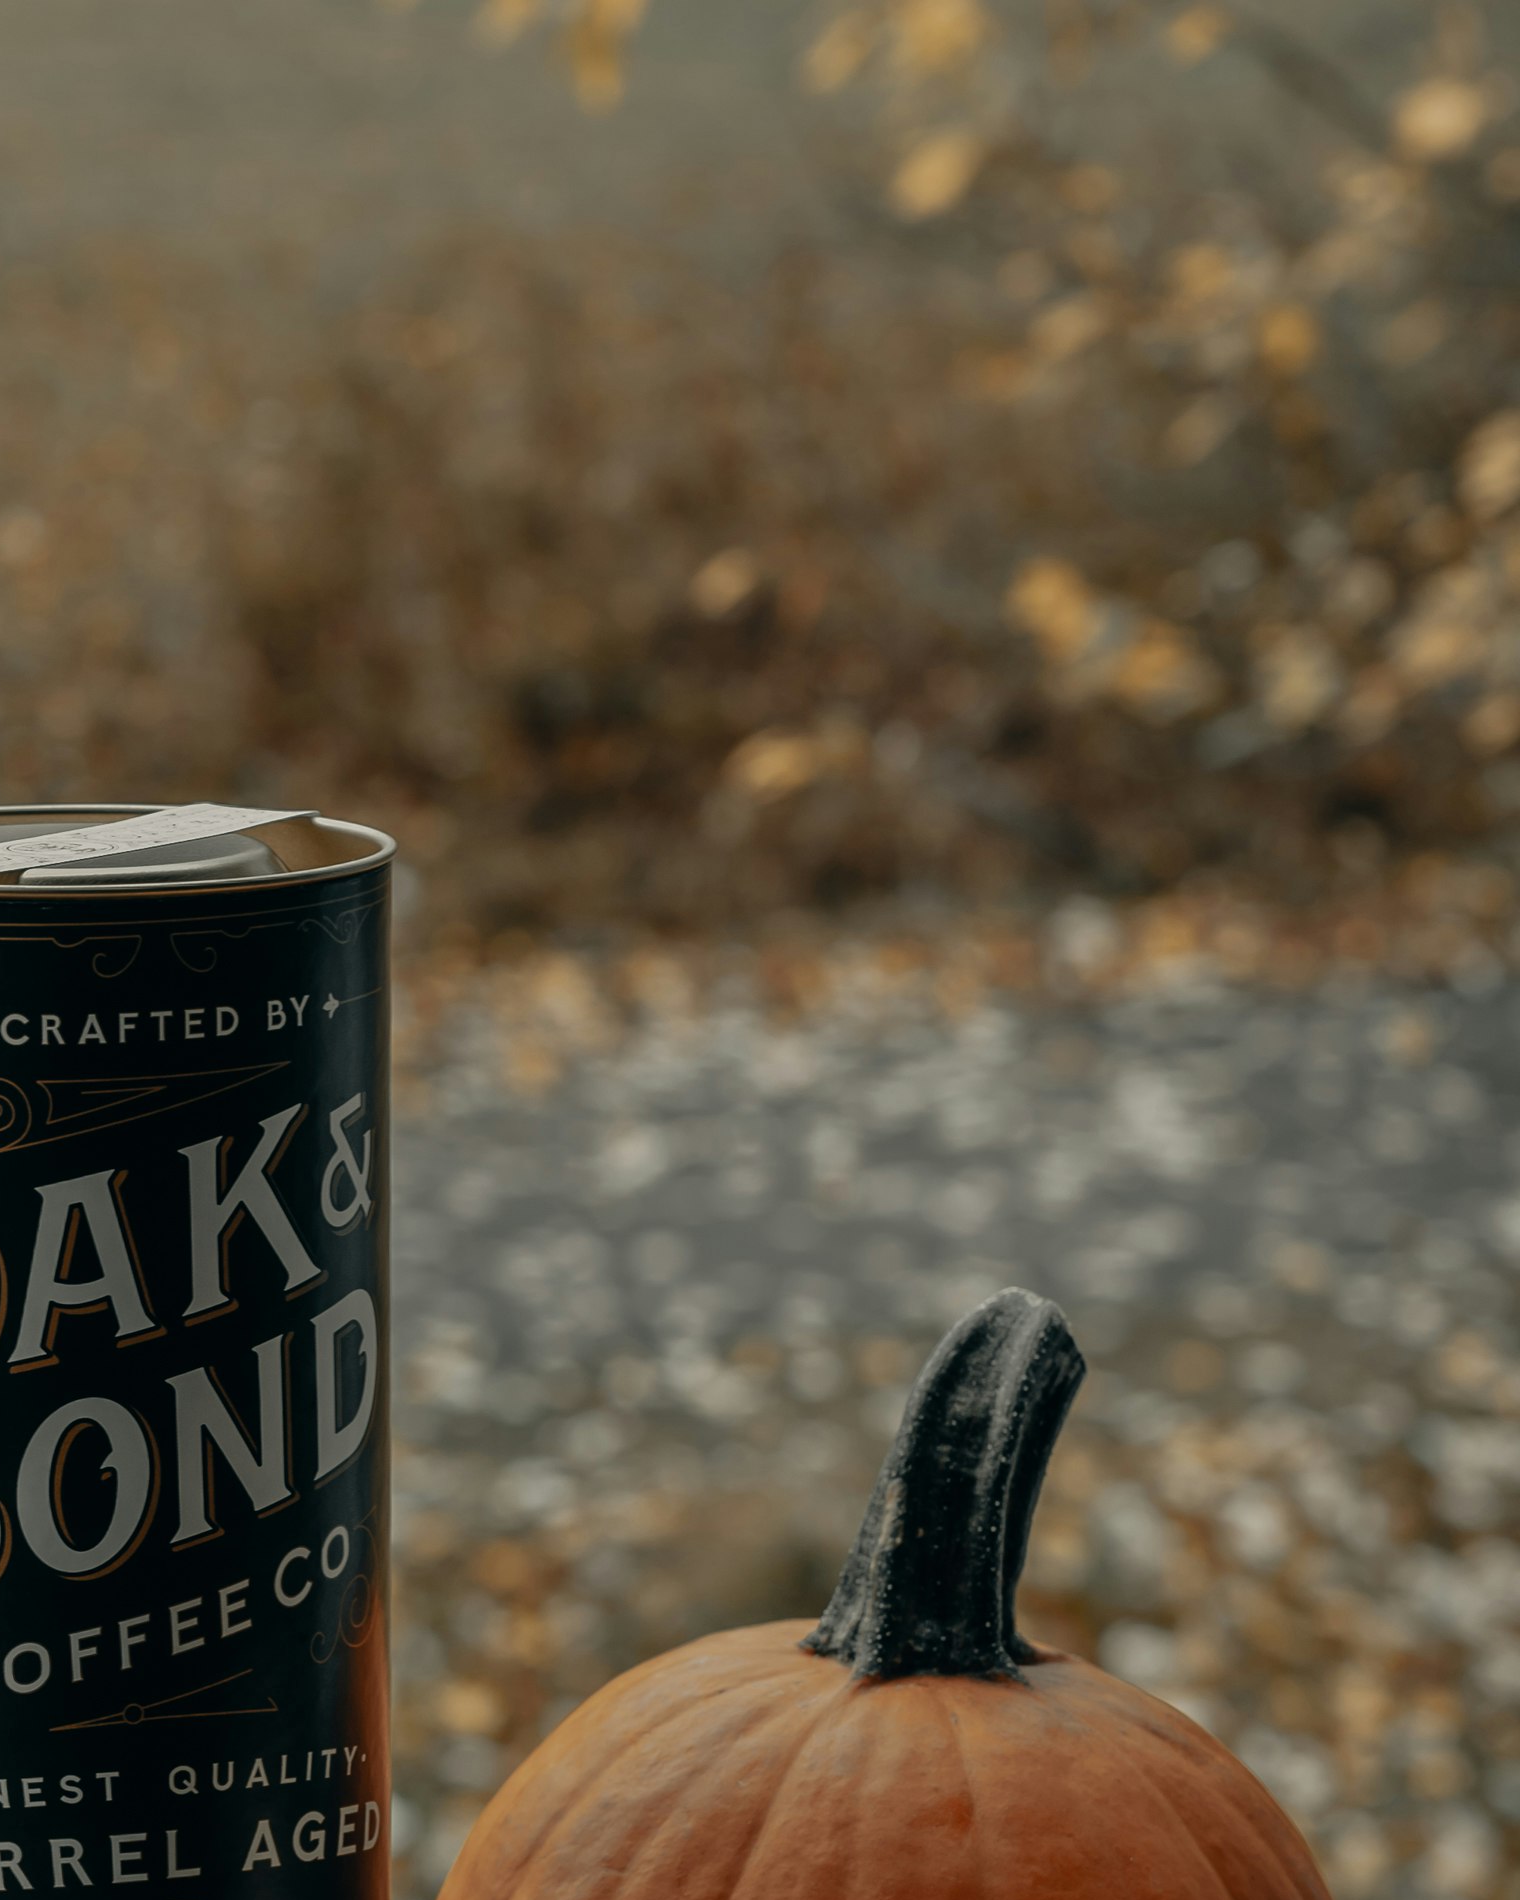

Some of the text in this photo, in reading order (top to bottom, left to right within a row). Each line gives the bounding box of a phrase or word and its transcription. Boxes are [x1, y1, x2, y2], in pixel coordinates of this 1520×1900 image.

[0, 994, 311, 1046] CRAFTED BY
[321, 1091, 374, 1236] &
[274, 1525, 350, 1608] CO
[168, 1745, 359, 1795] QUALITY
[242, 1801, 381, 1872] AGED
